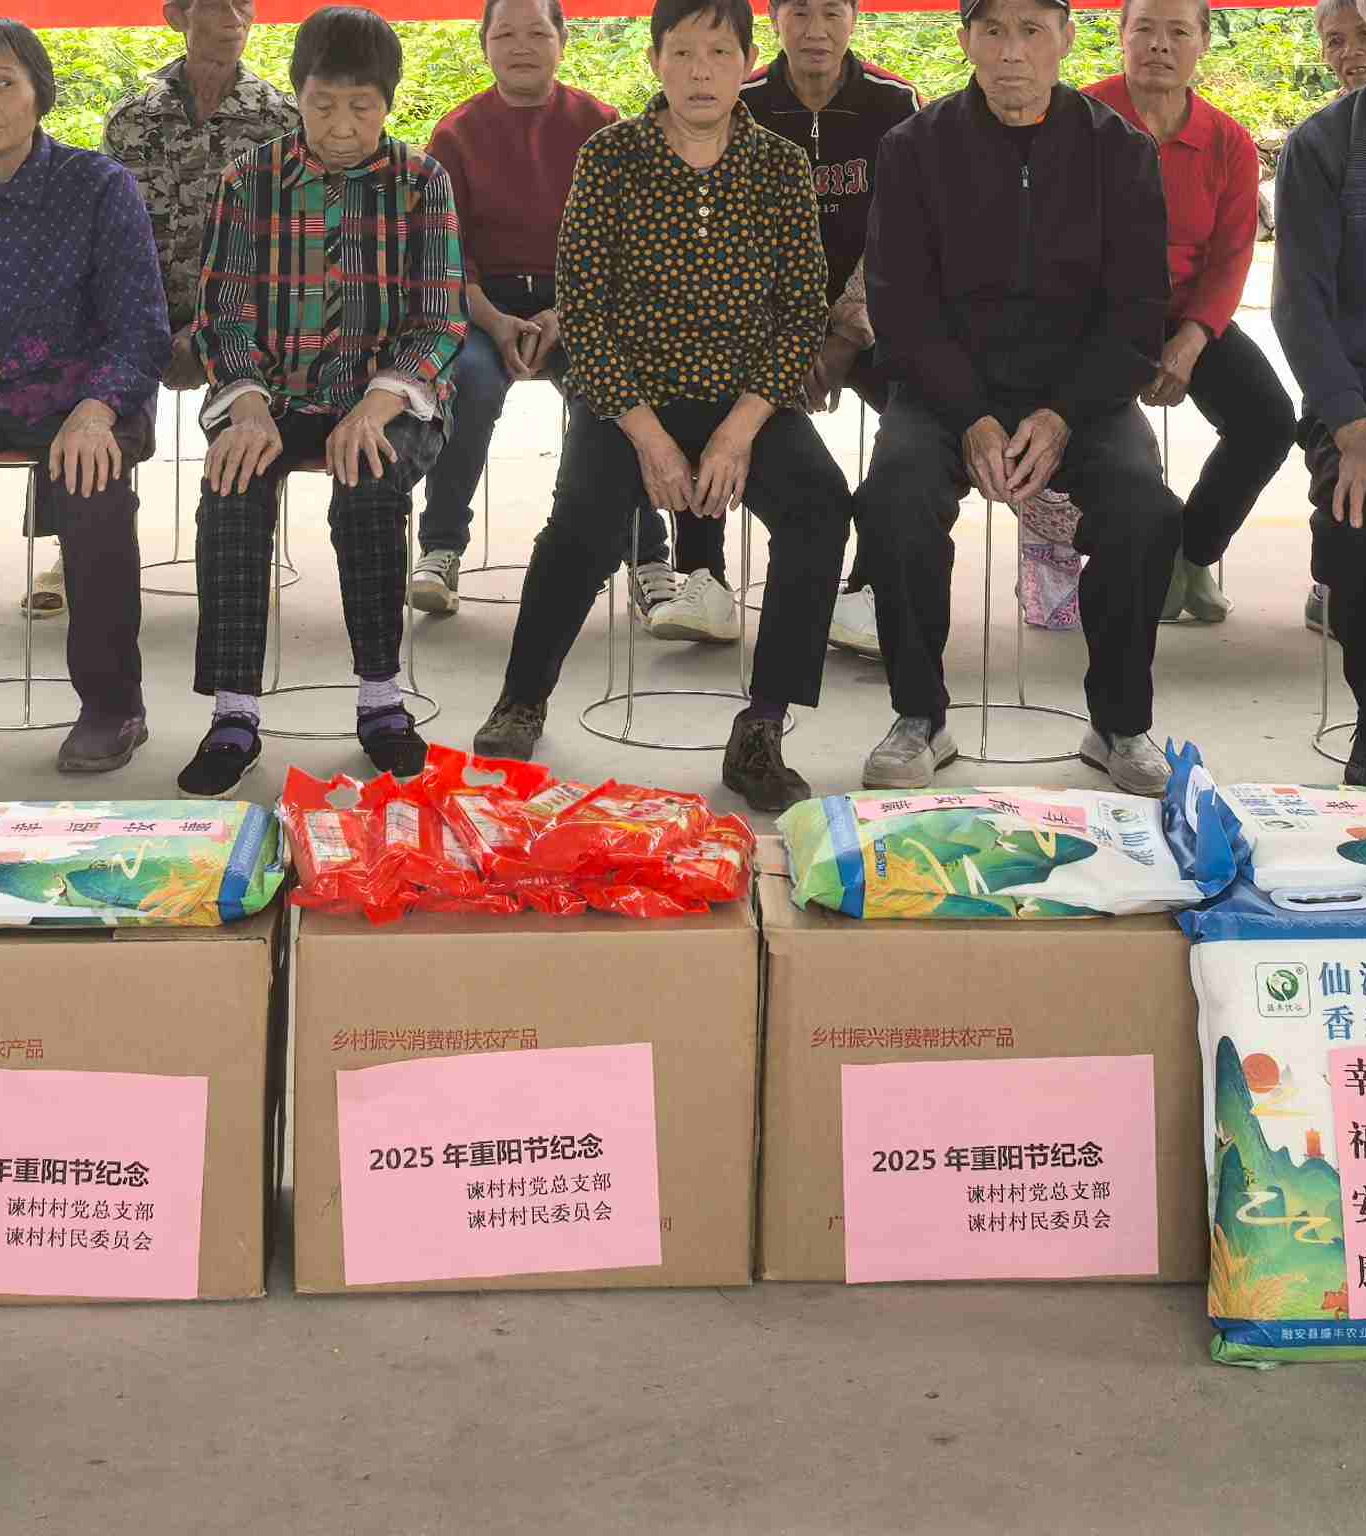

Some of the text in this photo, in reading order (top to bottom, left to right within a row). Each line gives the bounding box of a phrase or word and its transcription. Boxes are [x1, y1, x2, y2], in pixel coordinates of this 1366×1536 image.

[331, 1028, 539, 1052] 乡村振兴消费帮扶农产品
[810, 1027, 1015, 1049] 乡村振兴消费帮扶农产品
[368, 1132, 604, 1171] 2025 年重阳节纪念
[871, 1141, 1104, 1173] 2025 年重阳节纪念
[466, 1172, 612, 1201] 谏村村党总支部
[966, 1180, 1112, 1205] 谏村村党总支部
[6, 1196, 155, 1222] 谏村村党总支部
[467, 1199, 613, 1230] 谏村村民委员会
[967, 1209, 1112, 1233] 谏村村民委员会
[4, 1225, 154, 1252] 谏村村民委员会
